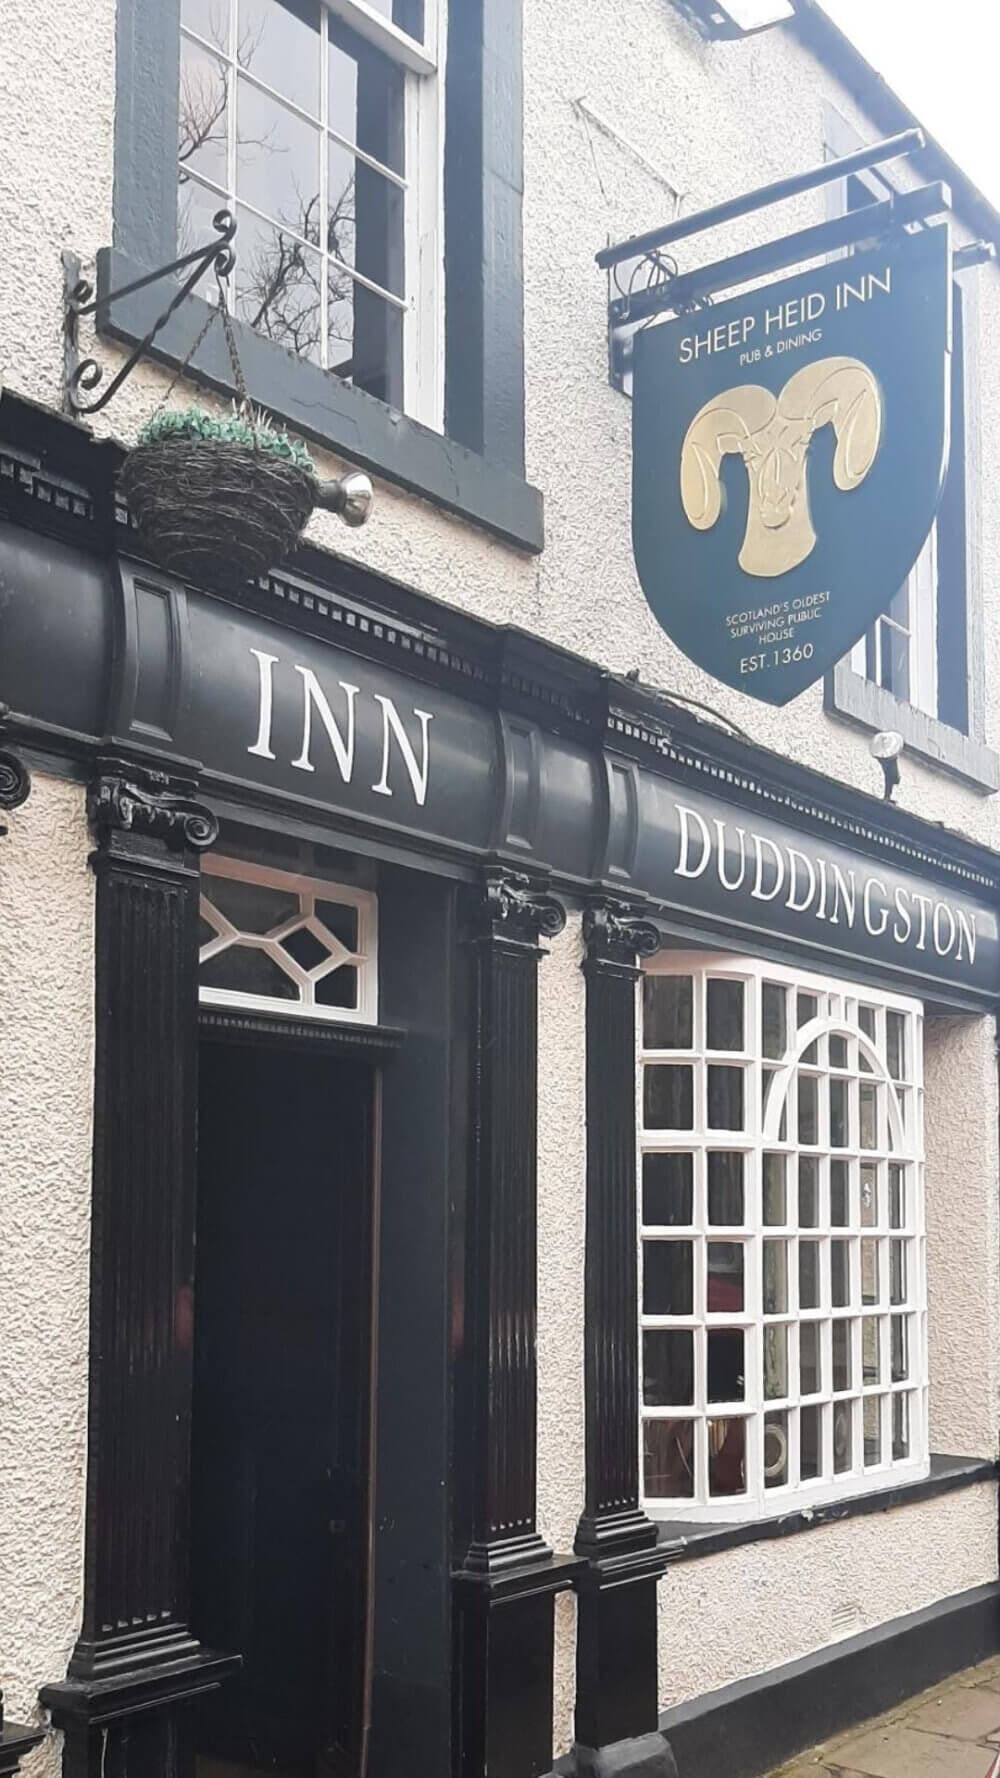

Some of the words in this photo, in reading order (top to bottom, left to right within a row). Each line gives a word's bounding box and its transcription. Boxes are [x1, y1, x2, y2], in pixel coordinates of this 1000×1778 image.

[679, 317, 755, 364] SHEEP
[765, 293, 826, 334] HEID
[836, 268, 892, 310] INN
[739, 350, 761, 366] PUB
[764, 345, 774, 358] &
[777, 329, 823, 353] DINING
[725, 601, 789, 626] SCOTLAND'S
[792, 591, 831, 610] OLDEST
[730, 616, 785, 639] SURVIVING
[788, 608, 822, 625] PUBLIC
[758, 628, 794, 645] HOUSE
[247, 648, 433, 806] INN
[674, 804, 978, 965] DUDDINGSTON
